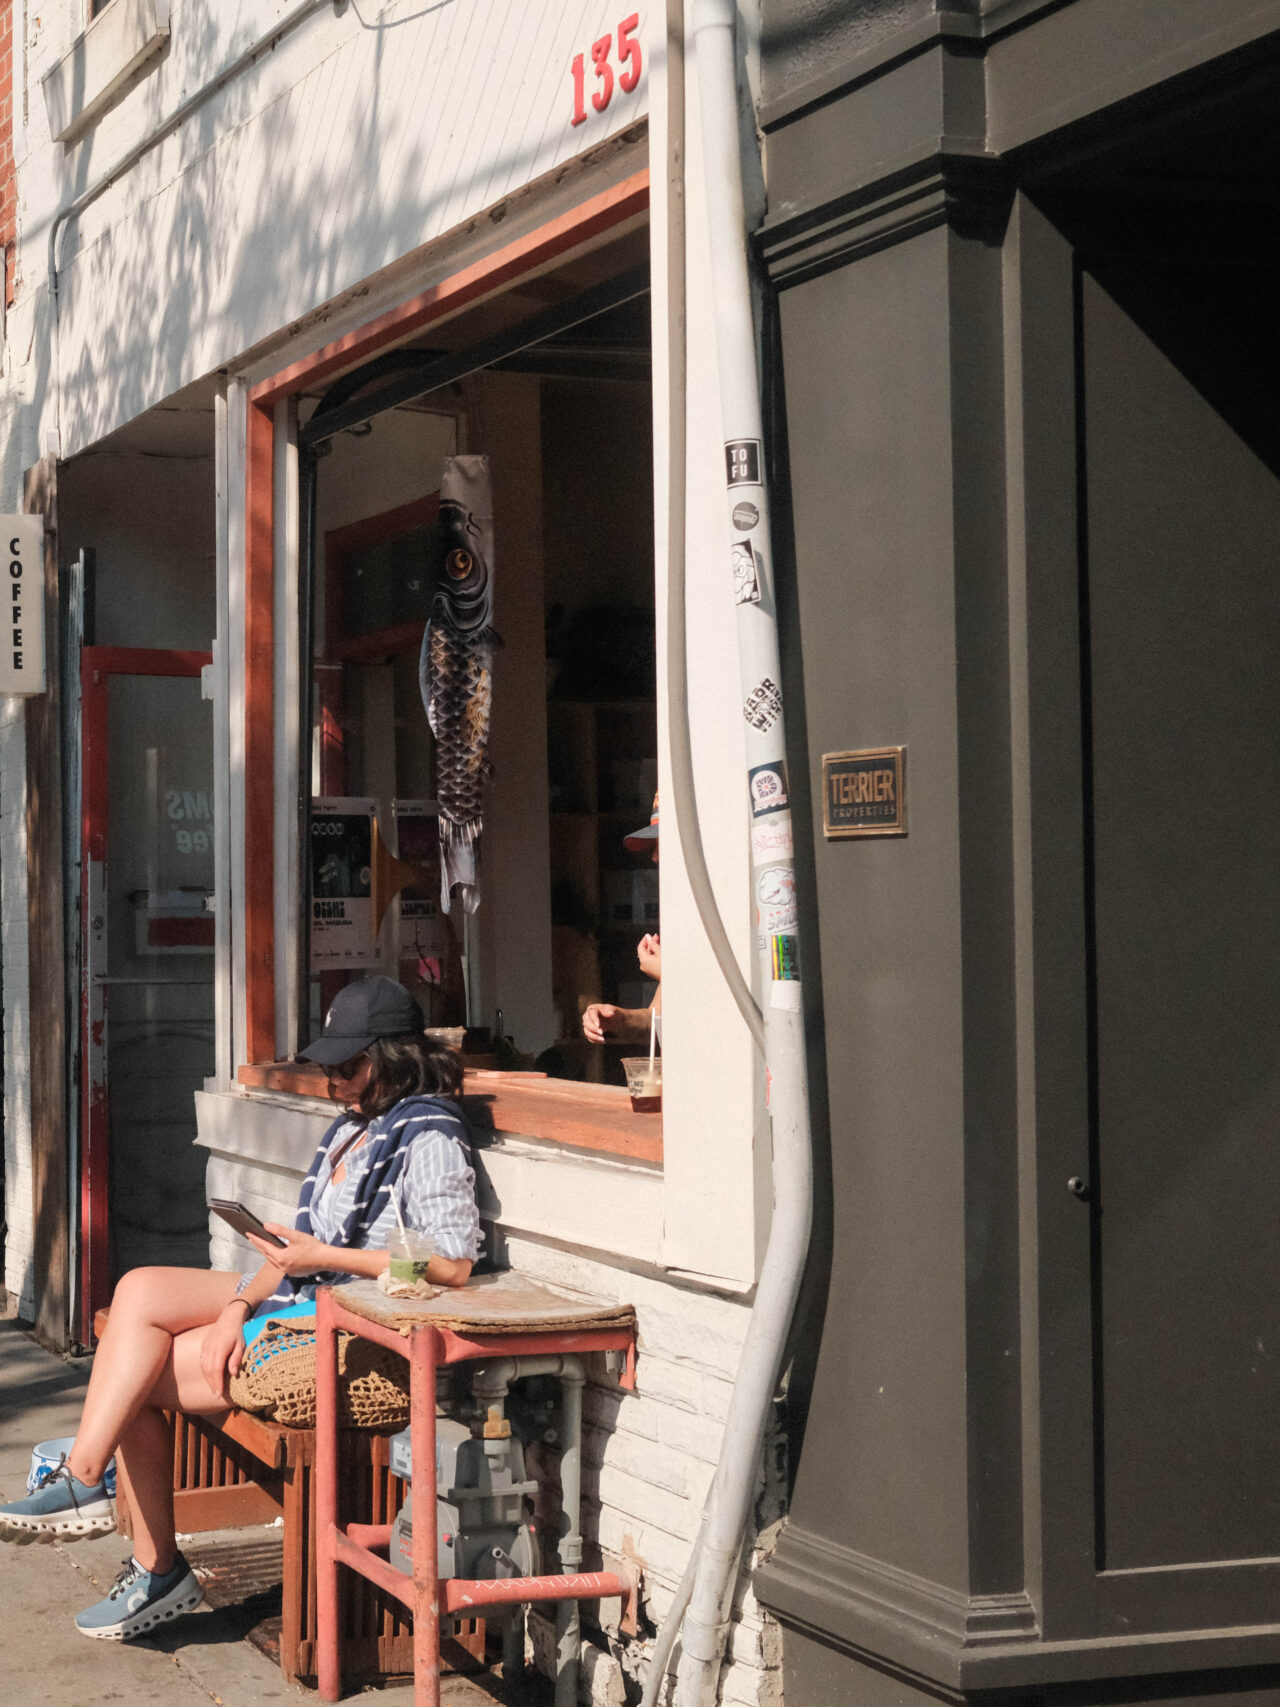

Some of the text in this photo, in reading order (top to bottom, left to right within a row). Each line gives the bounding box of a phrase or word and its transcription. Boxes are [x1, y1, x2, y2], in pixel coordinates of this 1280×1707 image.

[571, 12, 642, 128] 135
[731, 448, 748, 462] TO
[731, 464, 748, 479] FU
[9, 537, 23, 670] COFFEE
[830, 769, 895, 805] TERRIER
[833, 805, 896, 818] PROPERTIES
